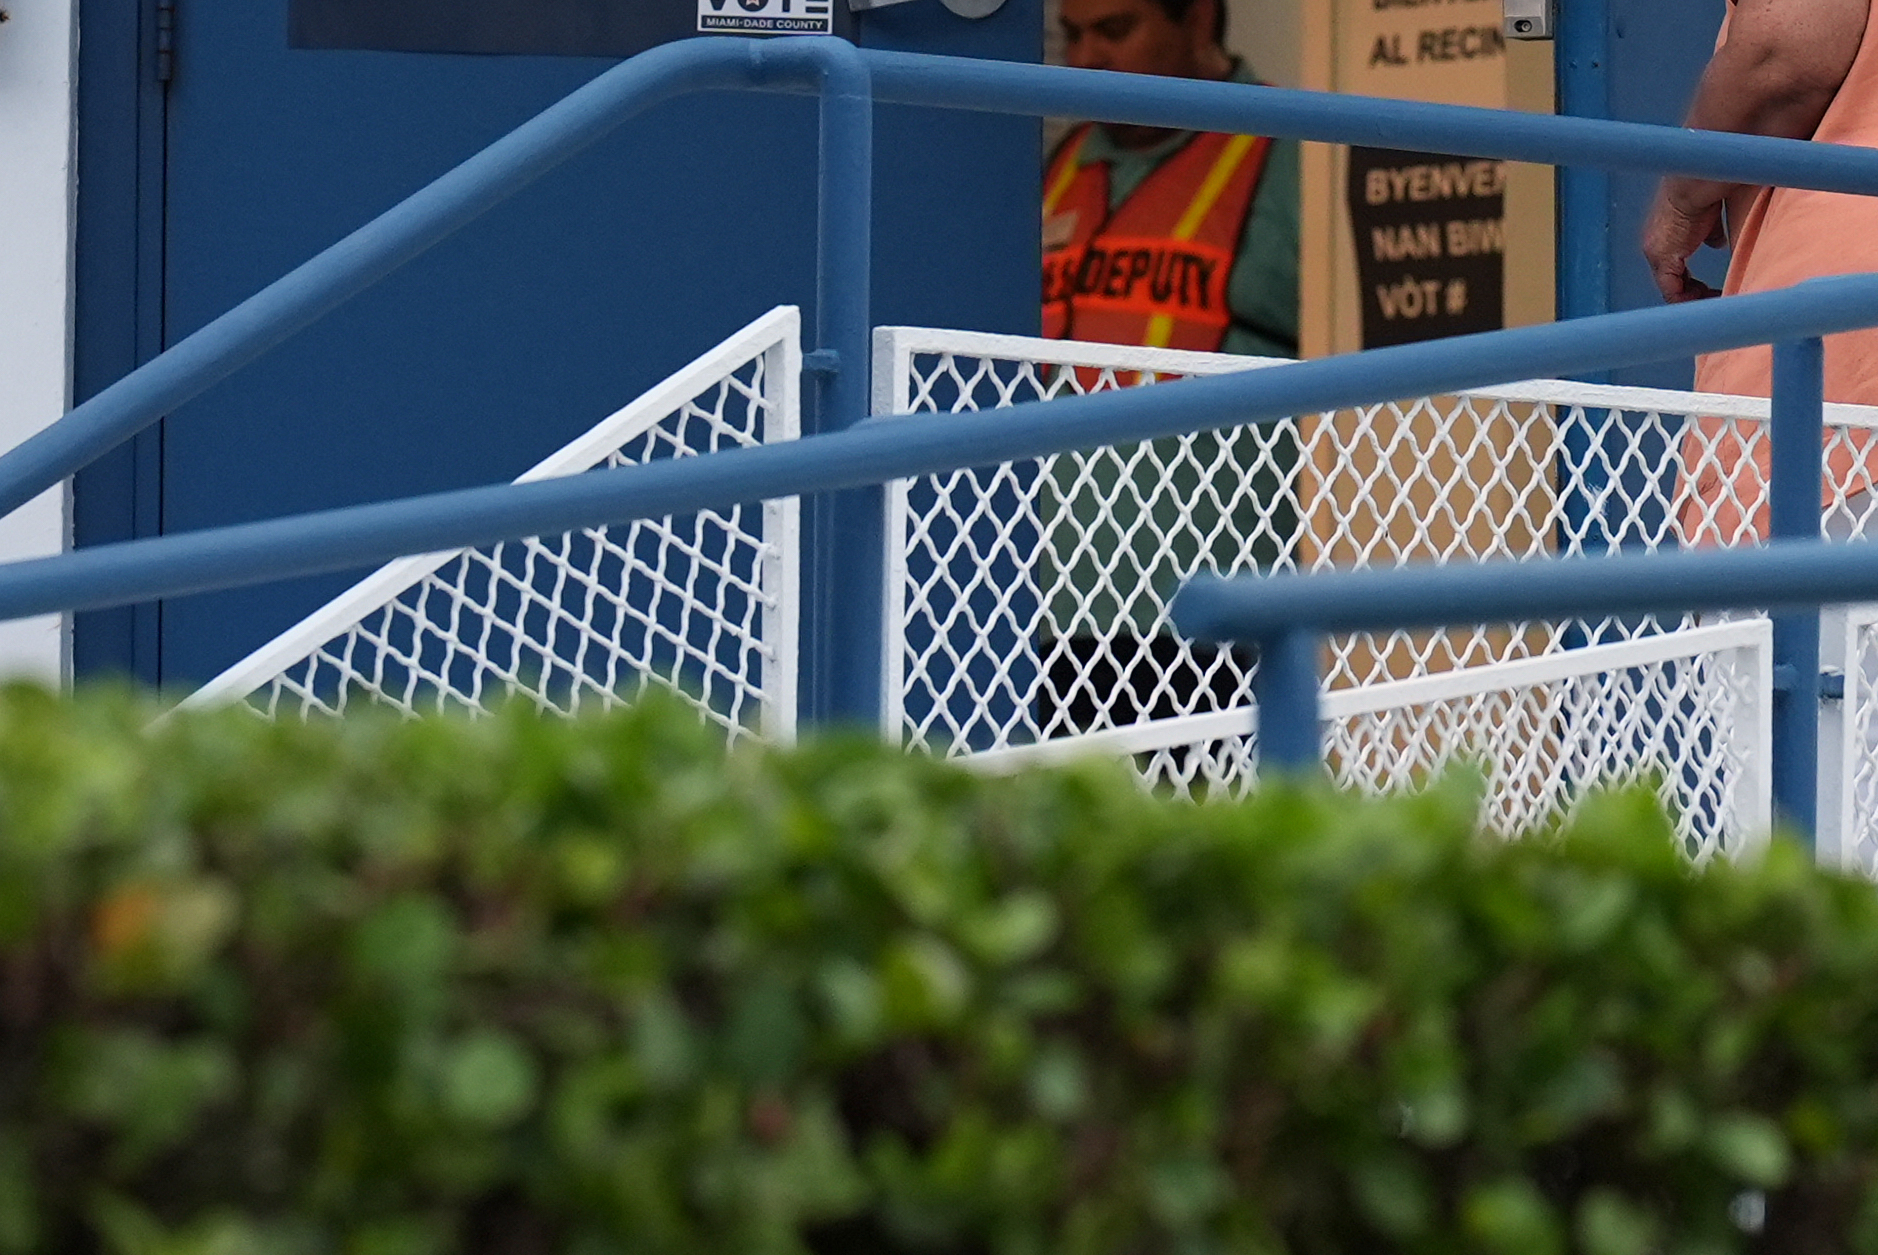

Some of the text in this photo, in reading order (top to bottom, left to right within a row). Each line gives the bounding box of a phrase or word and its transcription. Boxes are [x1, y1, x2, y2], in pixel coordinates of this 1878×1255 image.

[706, 18, 823, 29] MIAMI-DADE COUNTY
[1075, 248, 1216, 310] DEPUTY
